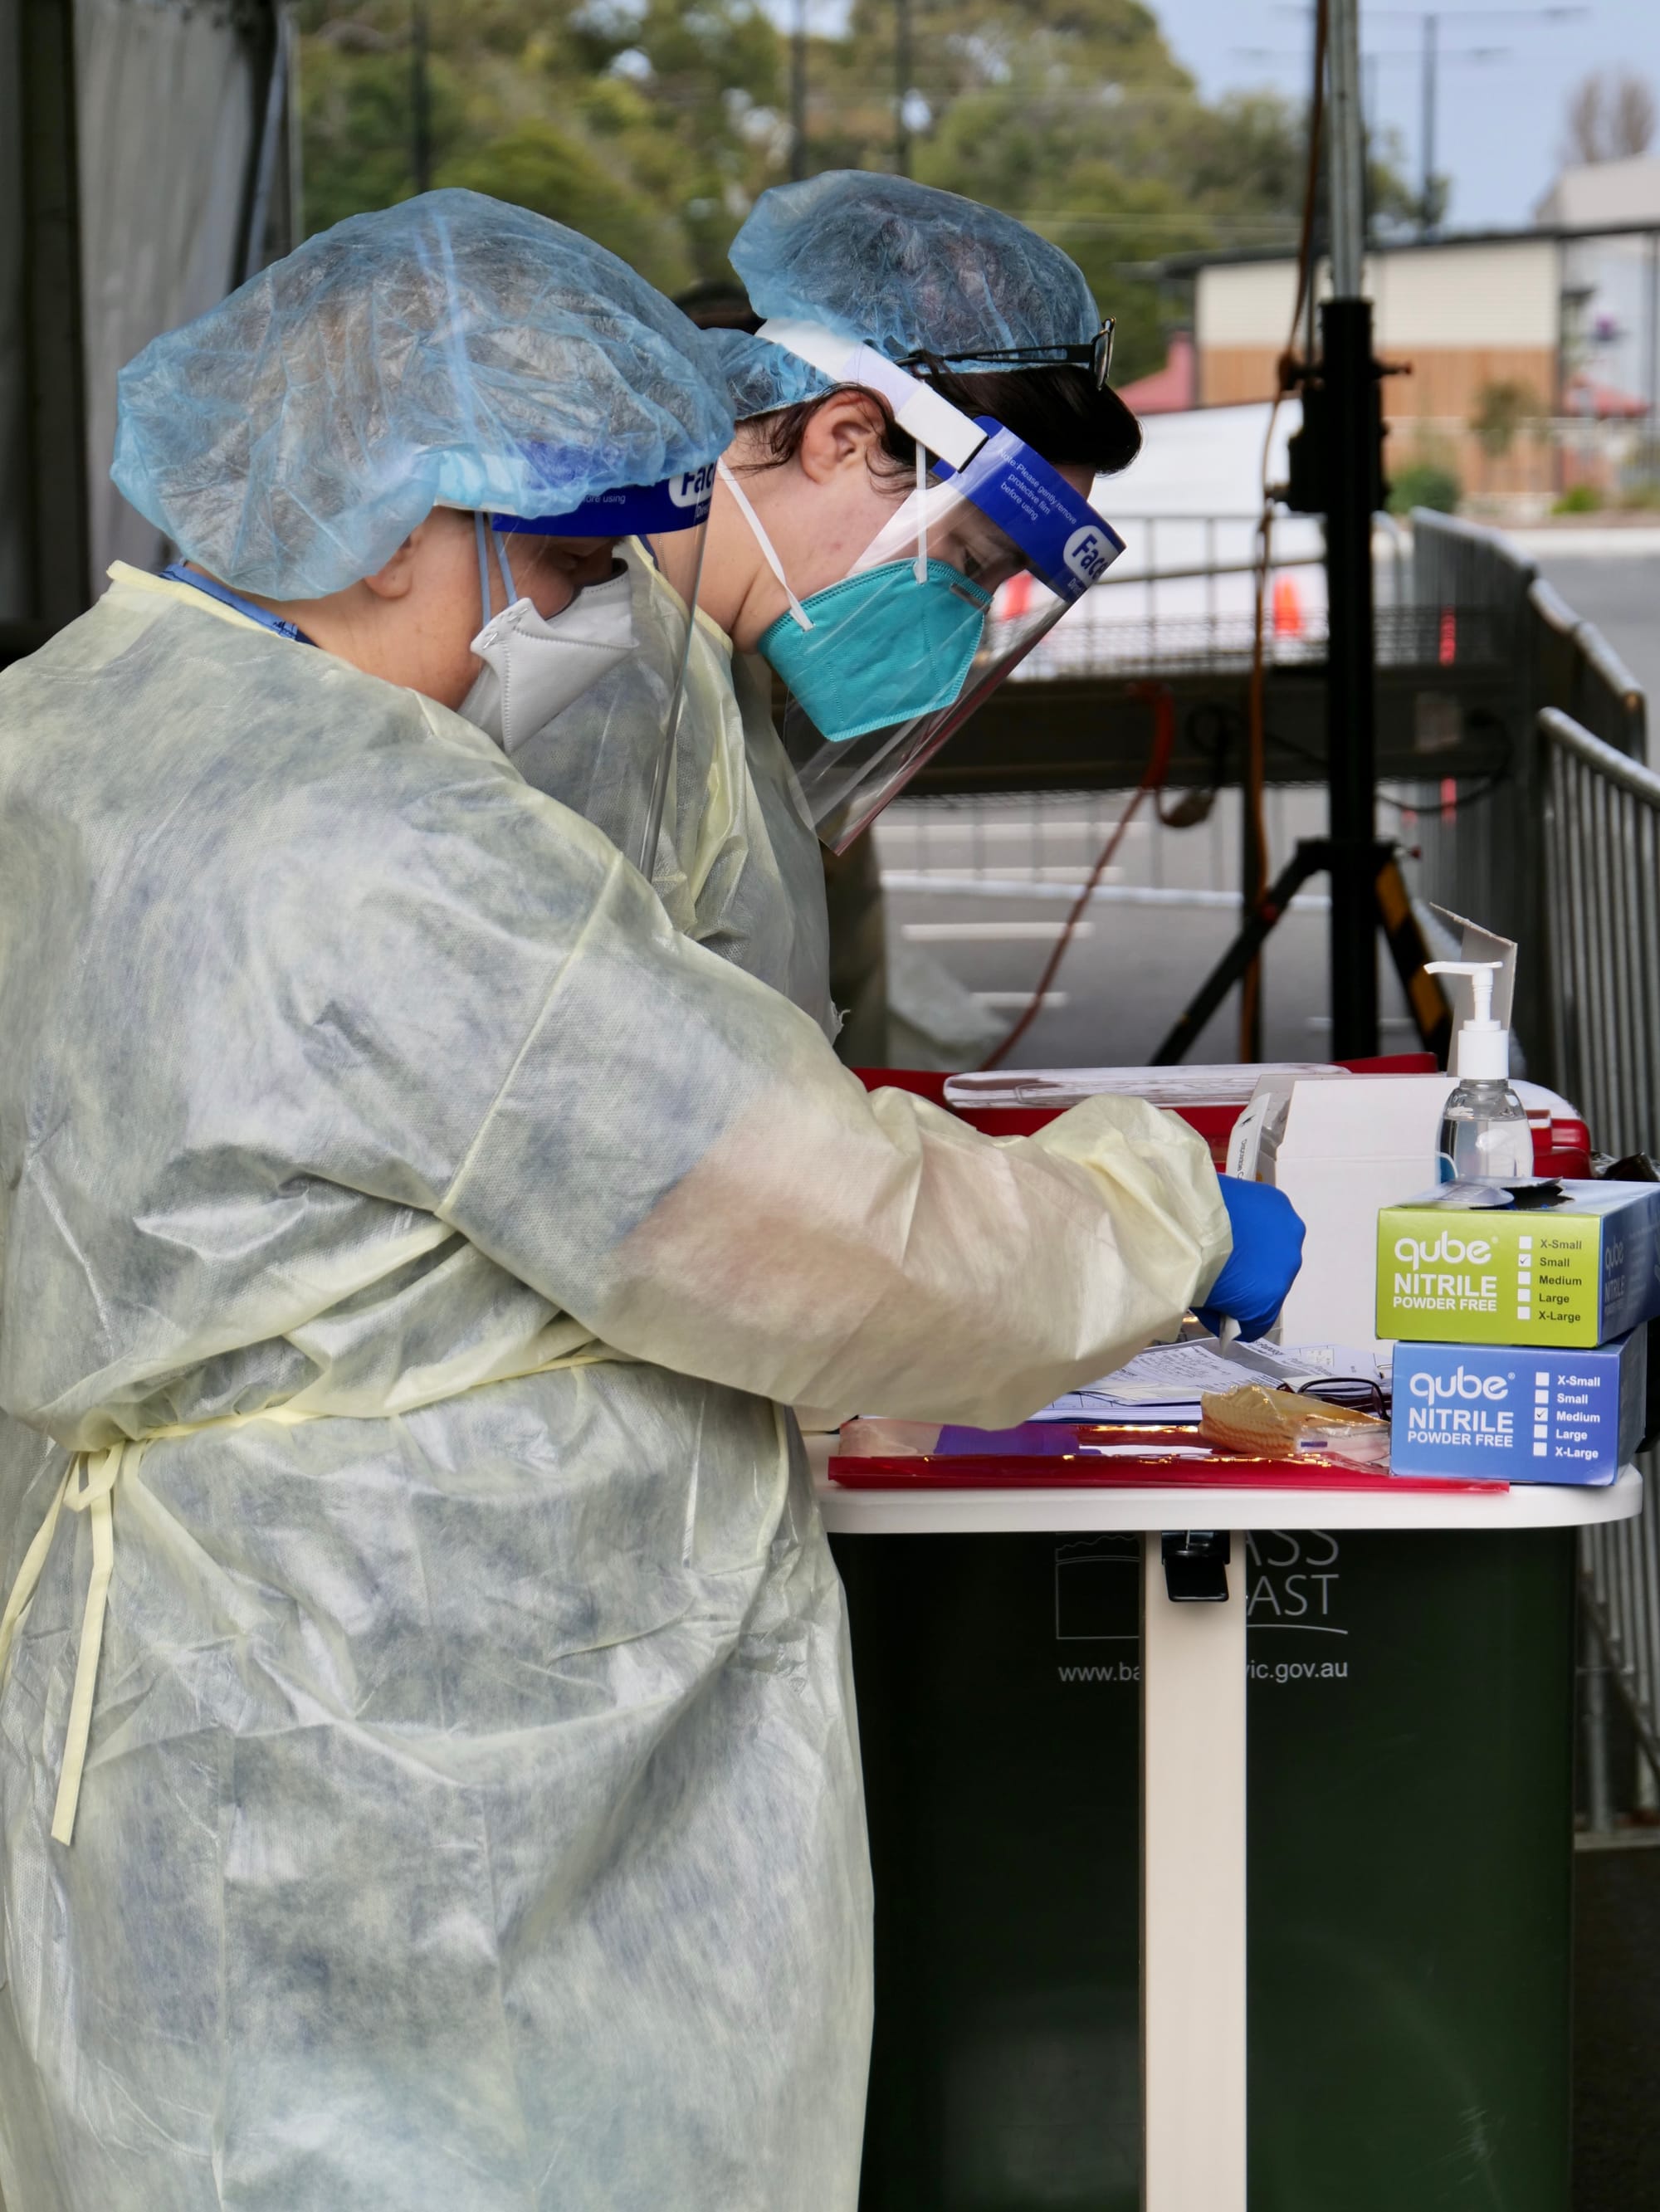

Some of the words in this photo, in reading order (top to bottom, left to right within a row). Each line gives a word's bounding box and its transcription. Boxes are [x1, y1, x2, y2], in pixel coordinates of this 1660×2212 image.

[603, 495, 626, 505] using
[1001, 481, 1022, 504] before
[1022, 501, 1038, 520] using
[1008, 474, 1040, 505] protective
[1039, 501, 1051, 515] film
[1056, 502, 1077, 525] remove
[1394, 1230, 1492, 1271] qube
[1540, 1239, 1582, 1250] X-Small
[1540, 1257, 1570, 1267] Small
[1394, 1272, 1497, 1297] NITRILE
[1539, 1275, 1582, 1286] Medium
[1393, 1296, 1457, 1311] POWDER
[1459, 1298, 1497, 1312] FREE
[1539, 1293, 1570, 1306] Large
[1538, 1311, 1581, 1324] X-Large
[1557, 1375, 1601, 1387] X-Small
[1557, 1393, 1589, 1404] Small
[1409, 1407, 1515, 1434] NITRILE
[1556, 1411, 1601, 1423] Medium
[1408, 1430, 1472, 1445] POWDER
[1475, 1433, 1514, 1448] FREE
[1555, 1428, 1588, 1442] Large
[1555, 1446, 1599, 1460] X-Large
